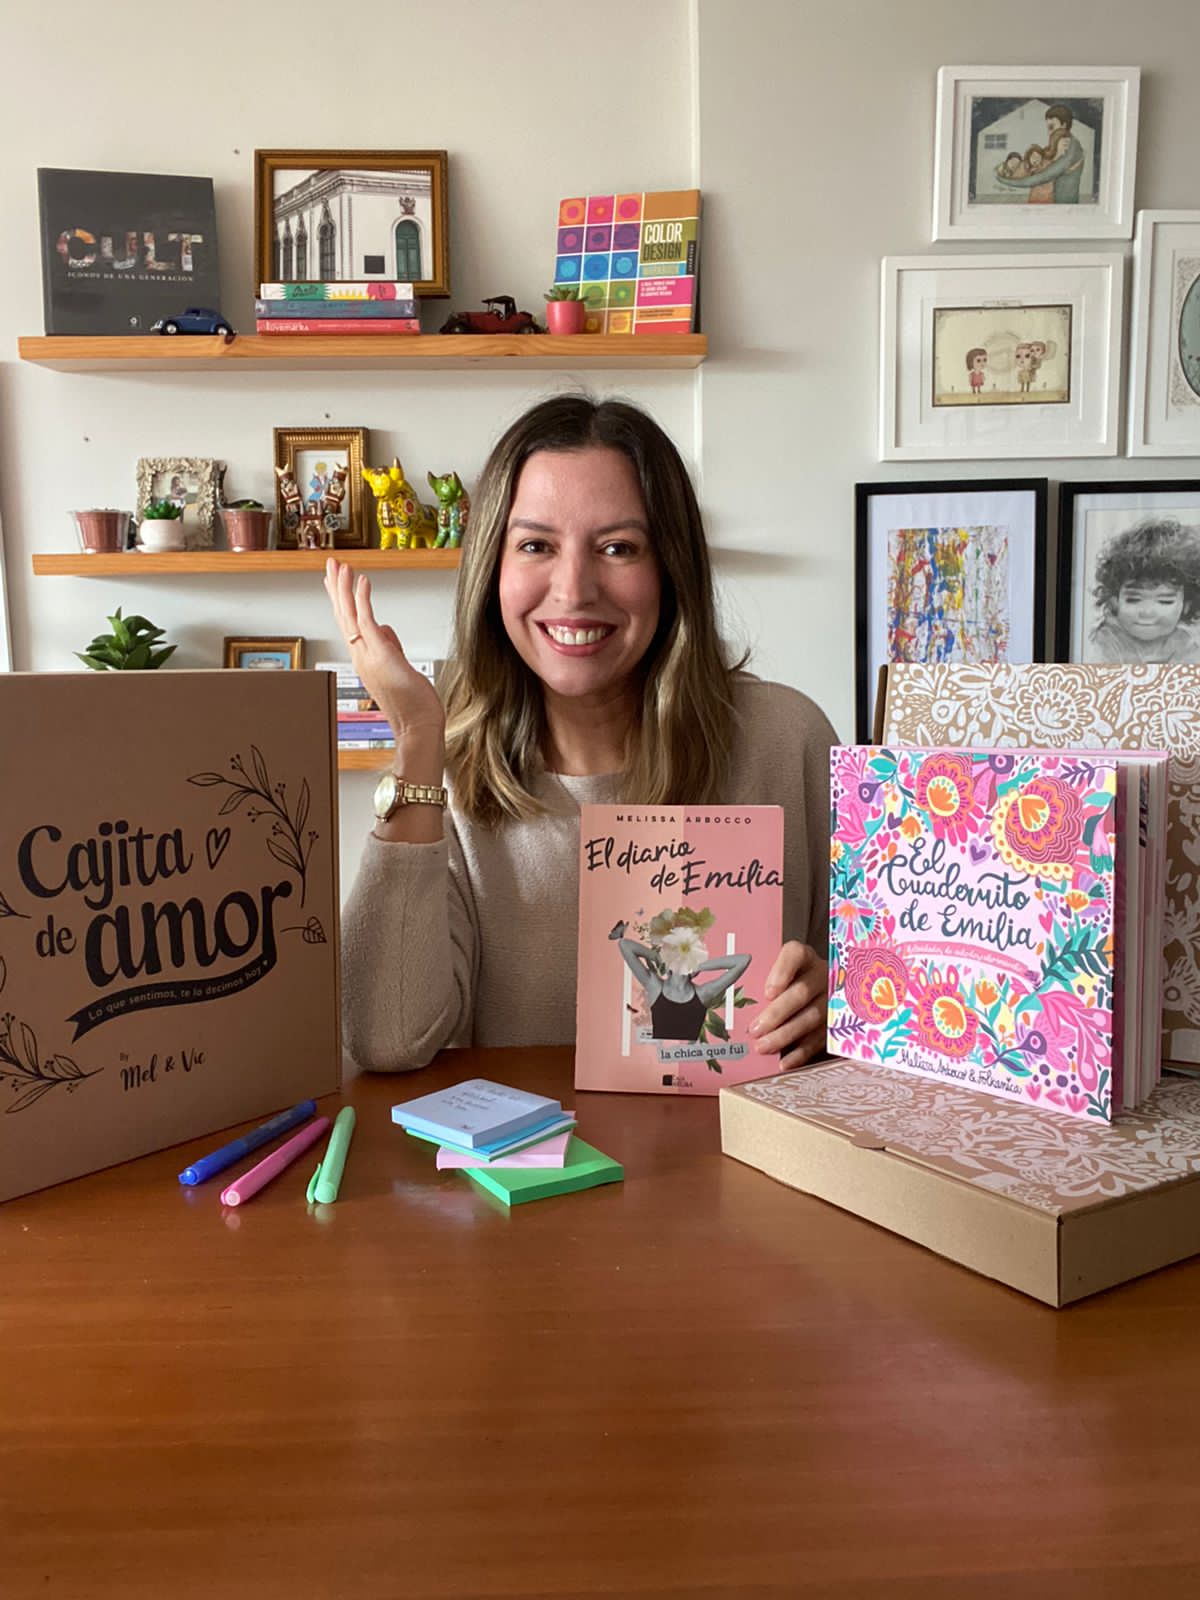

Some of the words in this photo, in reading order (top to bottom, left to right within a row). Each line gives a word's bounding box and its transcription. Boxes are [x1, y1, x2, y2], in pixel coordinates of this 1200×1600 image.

[56, 229, 203, 271] CULT
[643, 241, 682, 261] DESIGN
[644, 222, 683, 244] COLOR
[616, 815, 676, 823] MELISSA
[685, 816, 752, 824] ARBOCCO
[18, 820, 194, 911] Cajita
[584, 837, 615, 871] El
[616, 838, 697, 874] diario
[908, 837, 947, 876] El
[650, 864, 680, 894] de
[680, 859, 785, 896] Emilia
[877, 854, 1031, 911] Cuadernito
[36, 914, 77, 957] de
[85, 881, 293, 987] amor
[899, 898, 932, 932] de
[937, 904, 1037, 951] Emilia
[88, 1008, 103, 1021] Lo
[106, 998, 125, 1013] que
[129, 990, 177, 1004] sentimos,
[180, 989, 190, 998] te
[193, 987, 203, 996] lo
[205, 978, 244, 995] decimos
[245, 966, 261, 980] hoy
[661, 1050, 671, 1059] la
[674, 1048, 703, 1058] chica
[706, 1047, 726, 1058] que
[729, 1045, 744, 1055] fui
[120, 1054, 158, 1091] Mel
[165, 1056, 175, 1072] &
